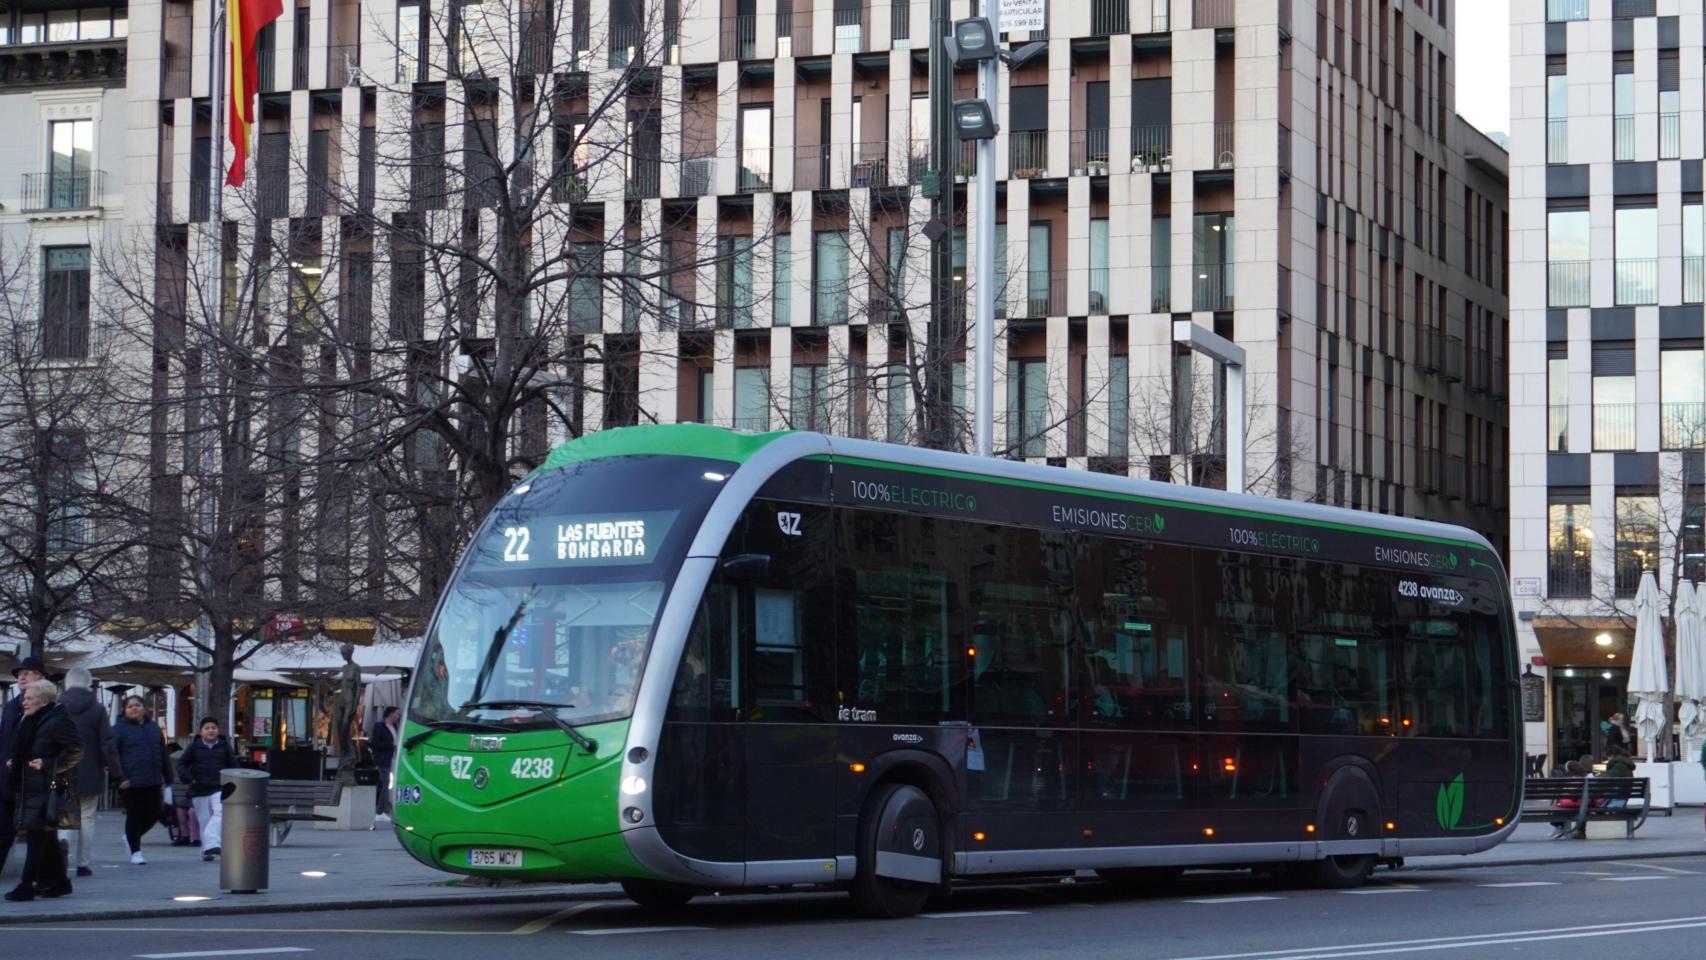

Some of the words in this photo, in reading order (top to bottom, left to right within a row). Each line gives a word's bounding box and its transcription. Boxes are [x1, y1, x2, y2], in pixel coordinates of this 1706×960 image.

[558, 524, 583, 542] LAS
[585, 520, 645, 541] FUENTES
[504, 526, 530, 562] 22
[558, 538, 645, 560] BOMBARDA
[1399, 580, 1418, 598] 4238
[1420, 585, 1455, 601] avanza
[851, 707, 877, 721] tram
[511, 757, 554, 779] 4238
[474, 851, 495, 865] 3765
[499, 852, 518, 865] MCY
